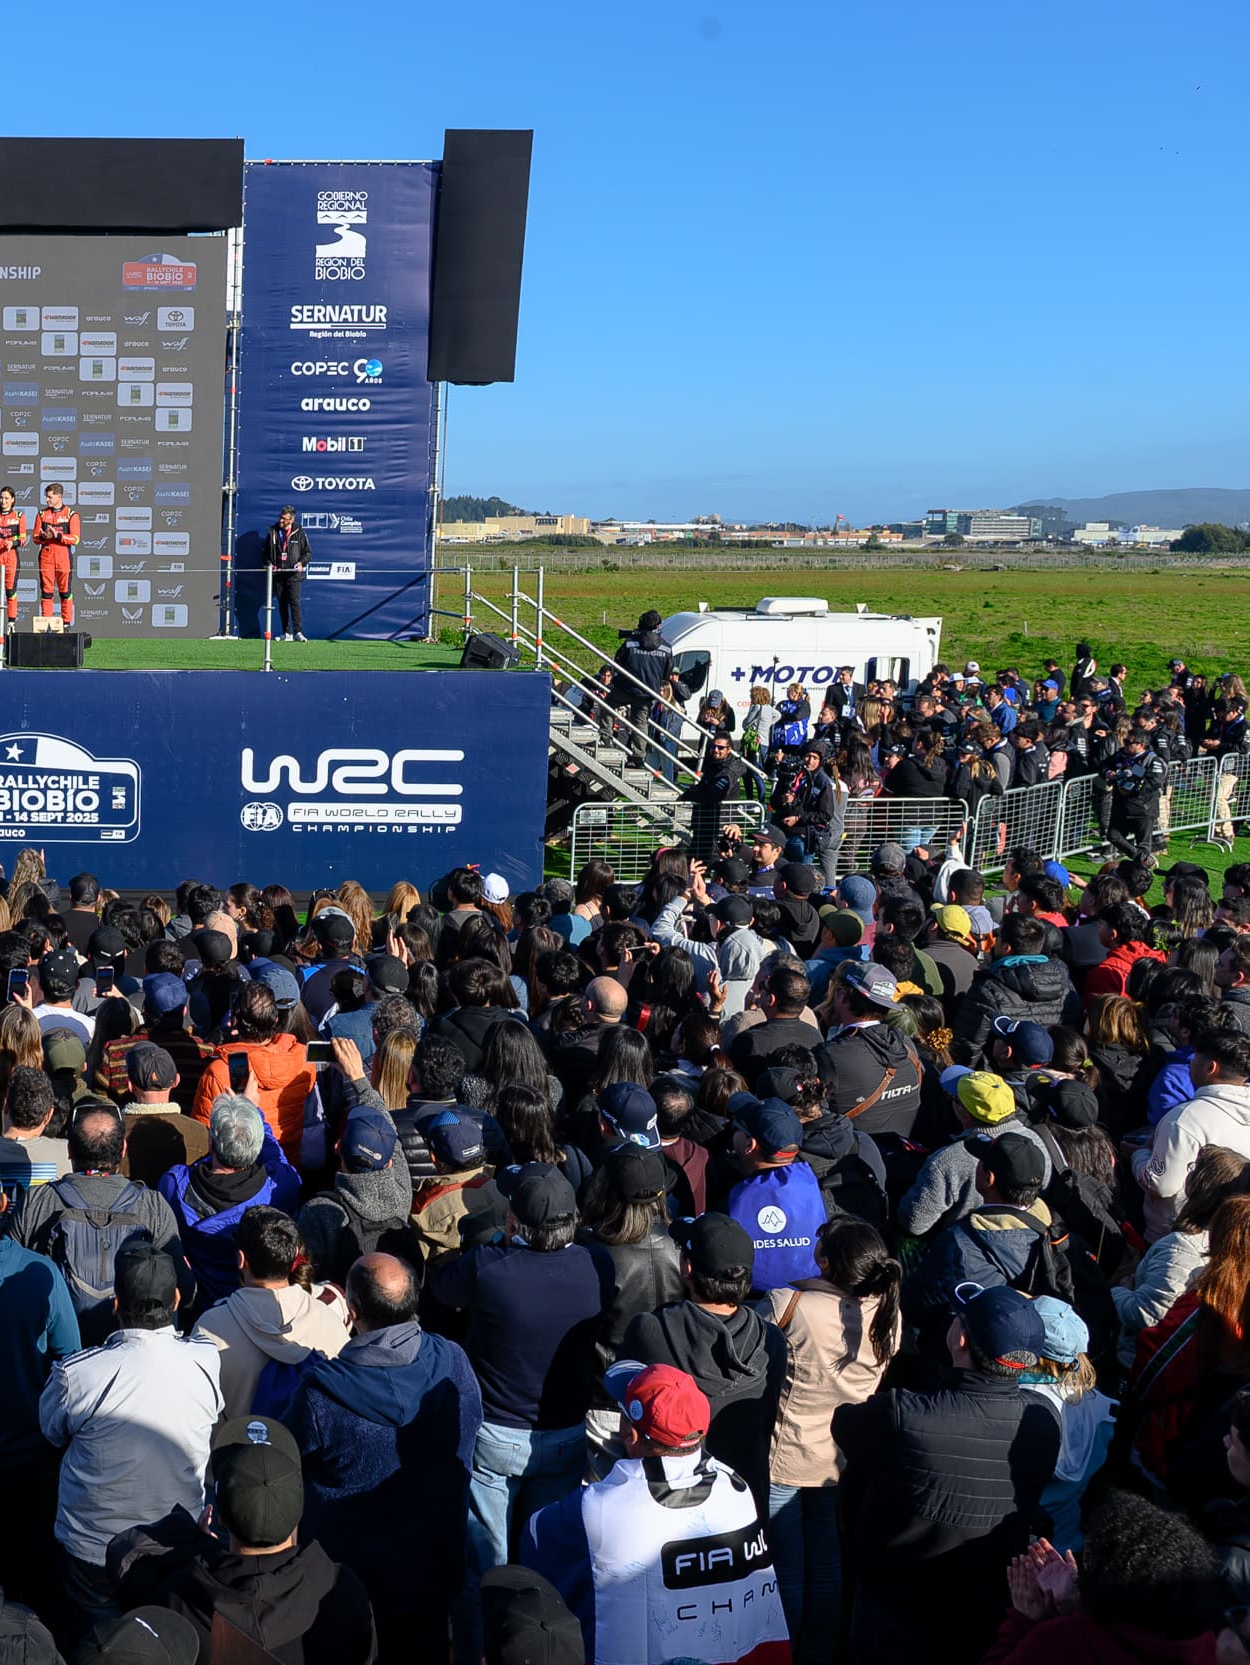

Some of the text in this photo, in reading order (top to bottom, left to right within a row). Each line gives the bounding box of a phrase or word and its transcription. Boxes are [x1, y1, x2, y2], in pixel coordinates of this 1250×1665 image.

[317, 191, 368, 201] GOBIERNO
[318, 201, 367, 210] REGIONAL
[351, 258, 365, 266] DEL
[315, 267, 365, 280] BIOBIO
[291, 305, 387, 322] SERNATUR
[291, 362, 349, 375] COPEC
[301, 398, 371, 411] arauco
[303, 437, 346, 451] Mobil
[316, 478, 375, 490] TOYOTA
[241, 747, 465, 796] WRC
[14, 811, 28, 821] 14
[30, 812, 63, 822] SEPT
[66, 812, 99, 823] 2025
[293, 808, 457, 818] FIA WORLD RALLY
[292, 824, 456, 833] CHAMPIONSHIP
[881, 1085, 912, 1100] TILTA
[753, 1237, 811, 1249] IDES SALUD
[675, 1548, 734, 1575] FIA
